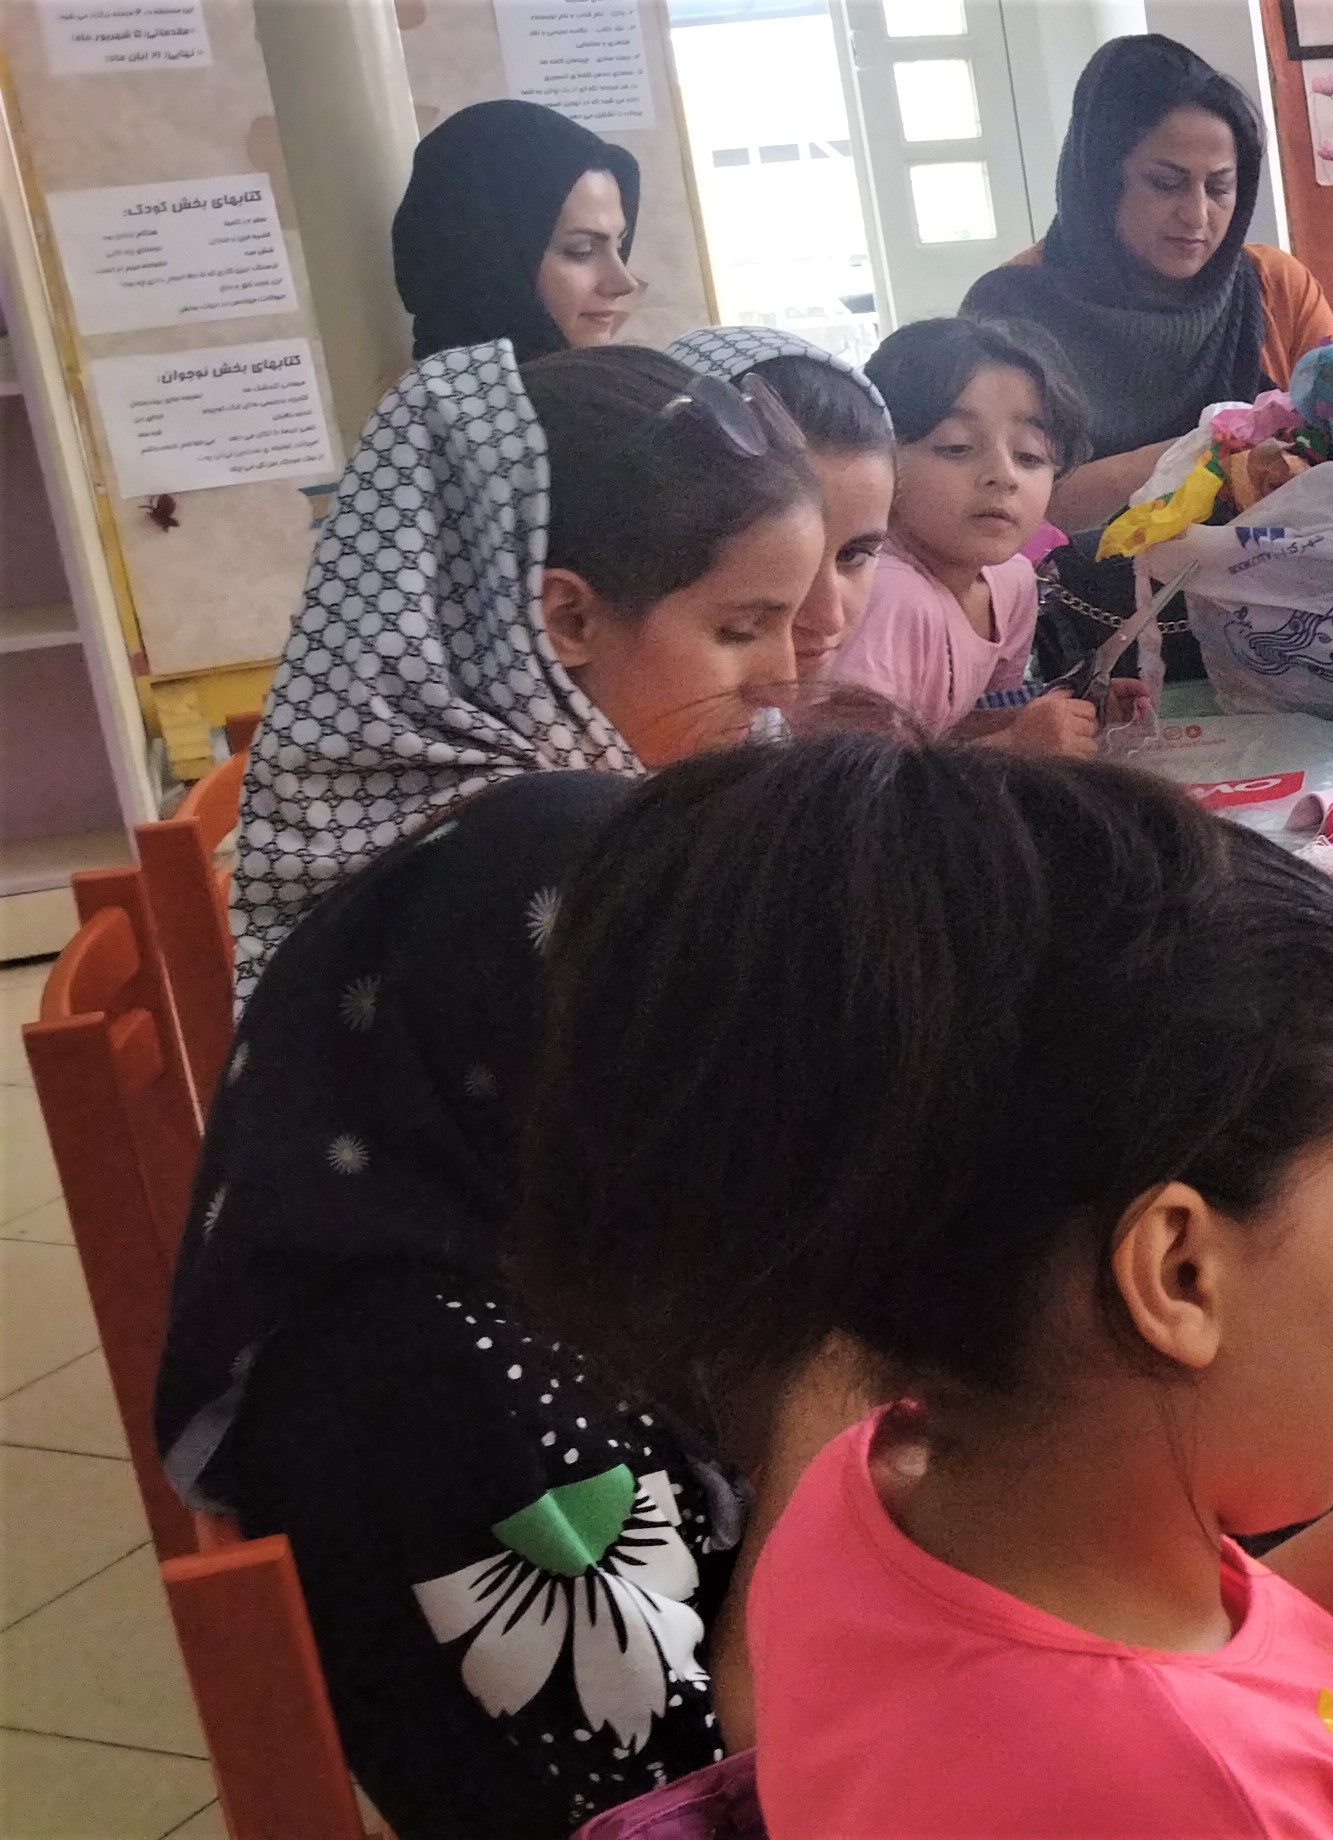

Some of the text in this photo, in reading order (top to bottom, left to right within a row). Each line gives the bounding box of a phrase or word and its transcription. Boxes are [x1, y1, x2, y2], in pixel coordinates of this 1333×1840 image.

[172, 196, 207, 213] بخش
[211, 190, 262, 210] کتابهای
[213, 362, 247, 377] بخش
[252, 354, 301, 373] کتابهای
